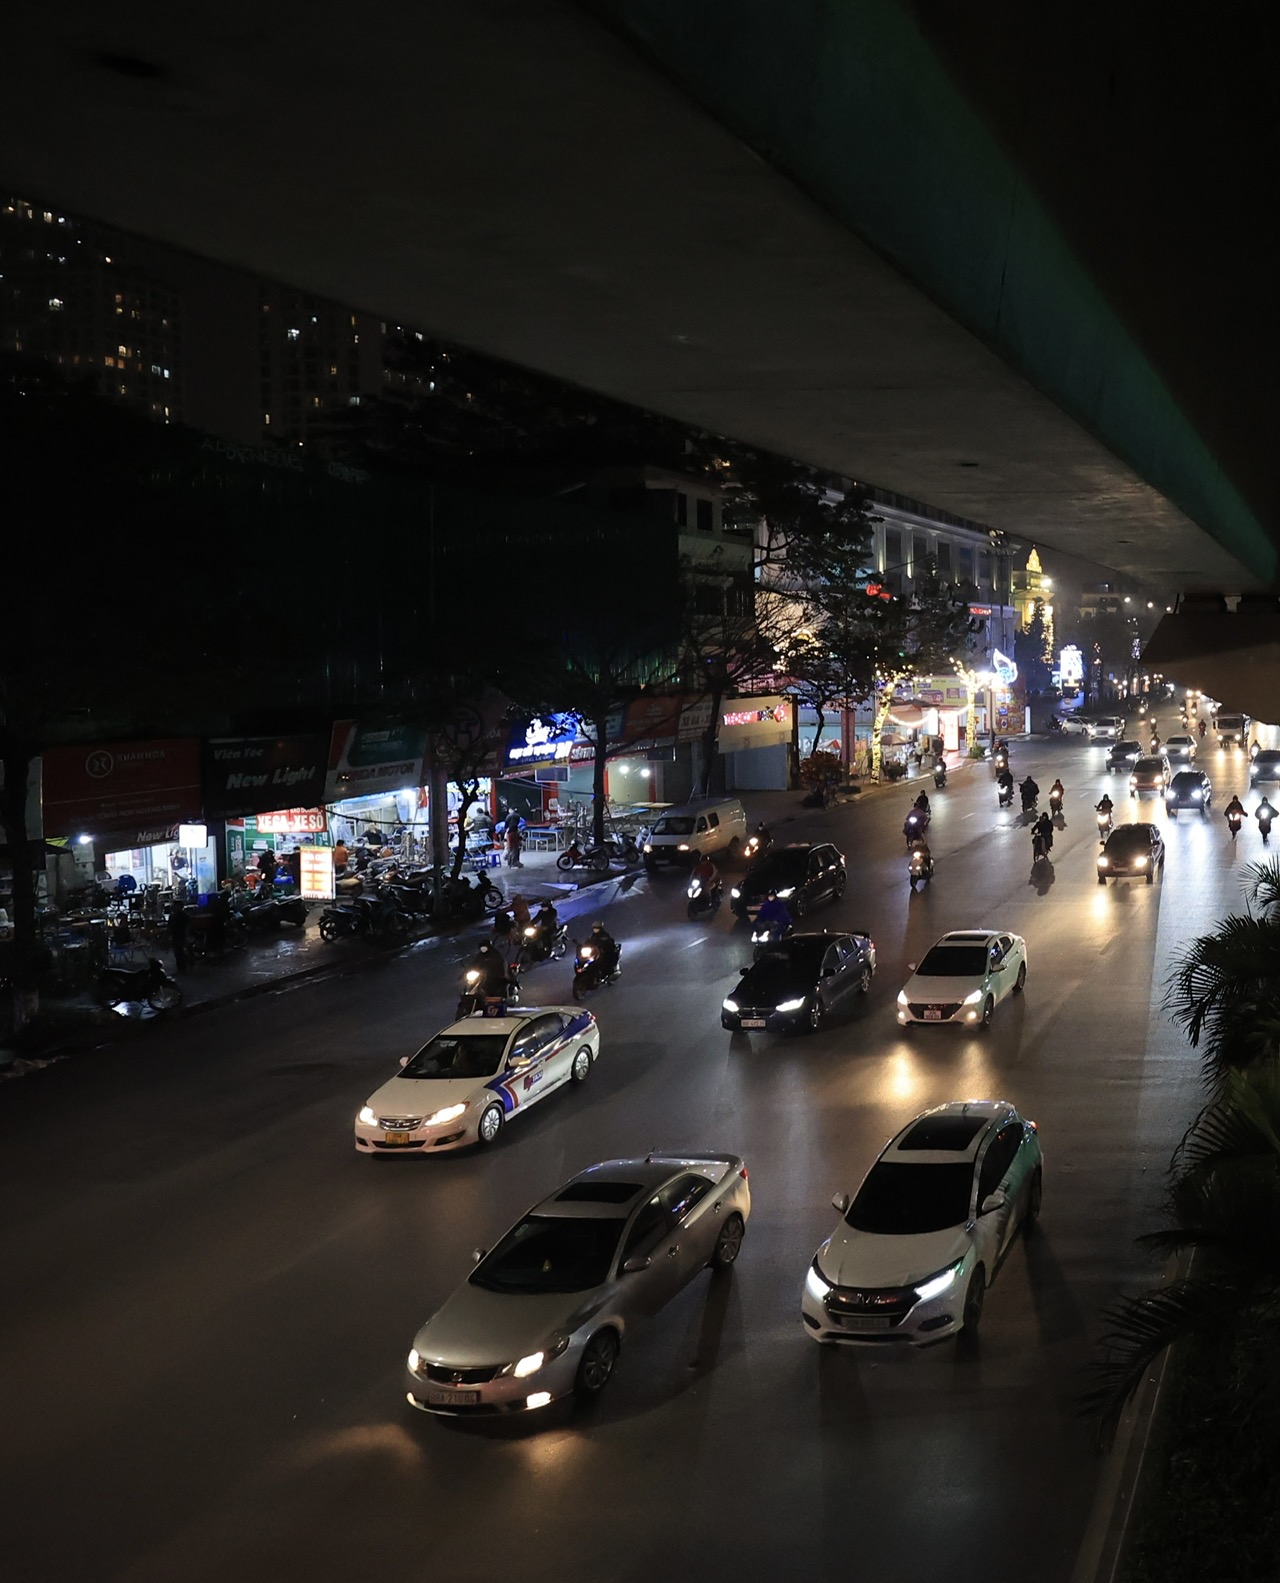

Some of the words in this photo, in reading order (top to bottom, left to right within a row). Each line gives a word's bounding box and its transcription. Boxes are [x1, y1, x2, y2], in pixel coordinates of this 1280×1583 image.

[226, 773, 269, 790] New
[272, 766, 316, 787] Light
[257, 815, 272, 831] XE
[293, 815, 309, 831] XE
[137, 831, 161, 842] New
